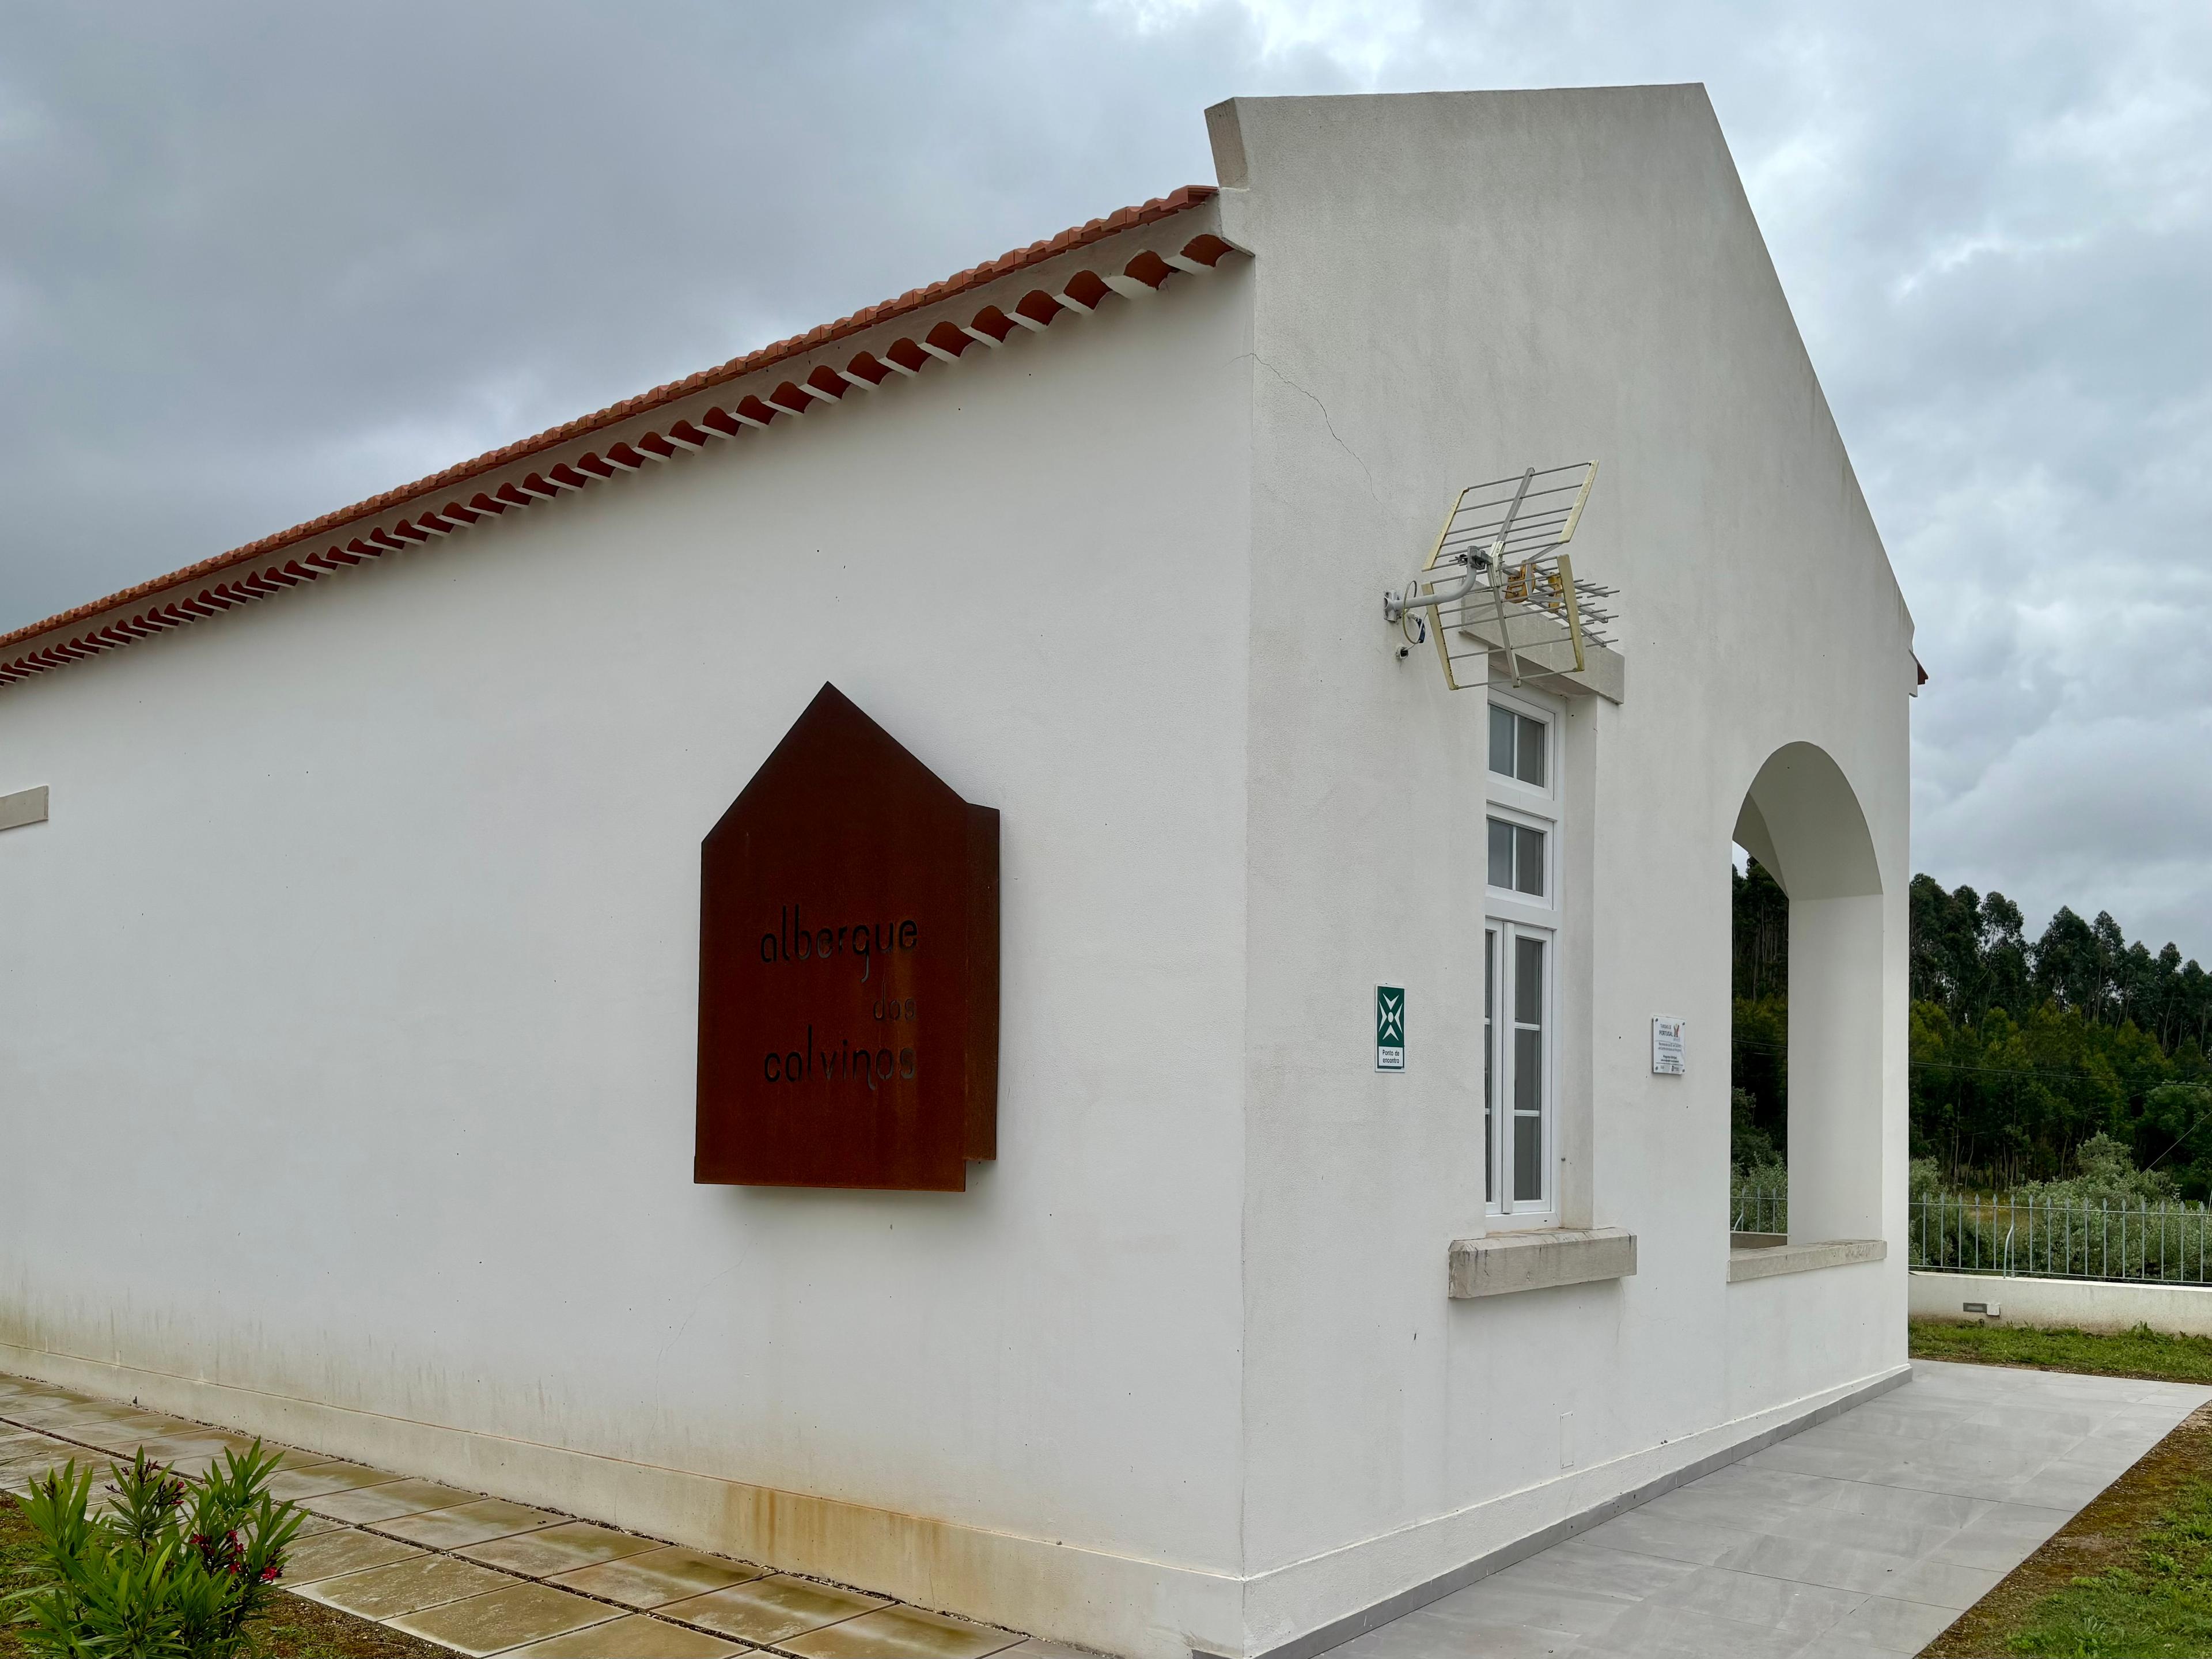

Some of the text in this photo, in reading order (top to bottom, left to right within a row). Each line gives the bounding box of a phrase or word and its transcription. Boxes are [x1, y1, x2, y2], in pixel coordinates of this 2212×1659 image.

[760, 903, 918, 983] albergue
[873, 980, 916, 1021] dos
[764, 1024, 916, 1091] calvinos
